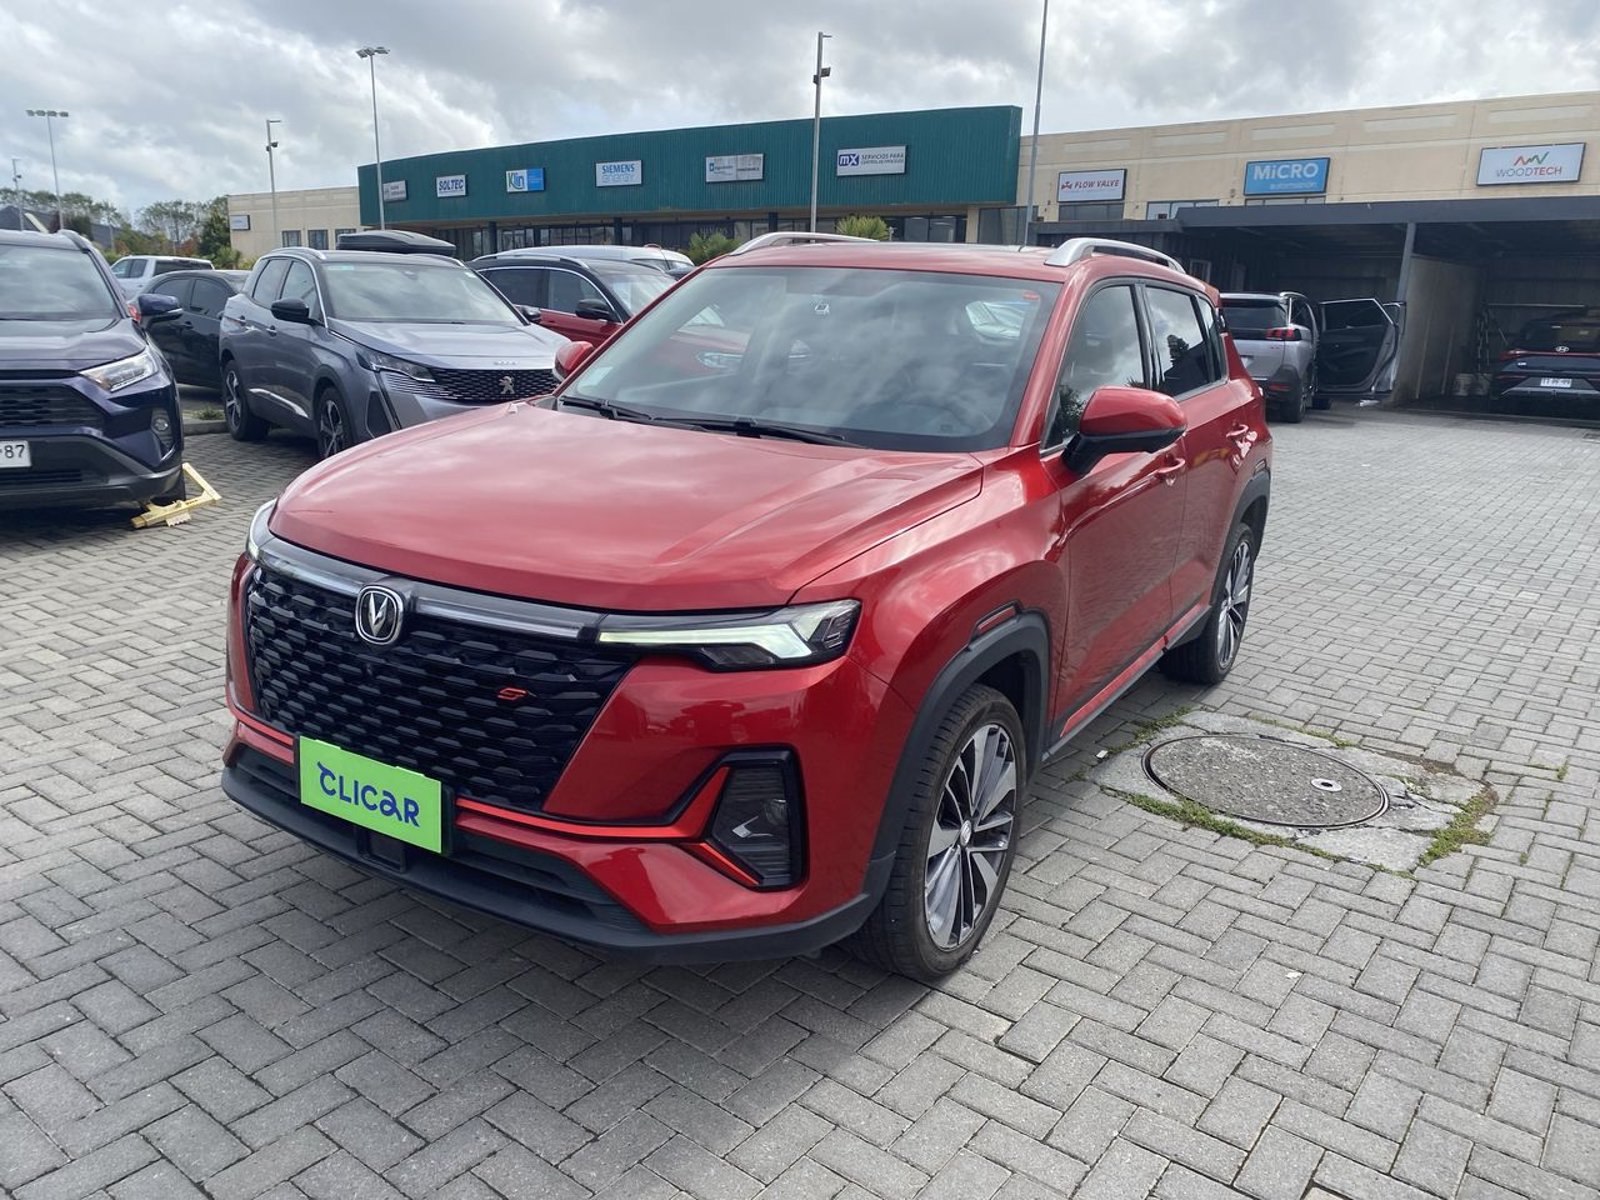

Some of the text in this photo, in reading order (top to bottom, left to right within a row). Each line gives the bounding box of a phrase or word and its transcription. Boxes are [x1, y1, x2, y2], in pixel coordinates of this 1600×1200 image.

[602, 163, 635, 174] SIEMENS
[1496, 166, 1562, 177] WOODTECH
[439, 179, 464, 191] SOLTEC
[1074, 179, 1120, 189] FLOW VALVE
